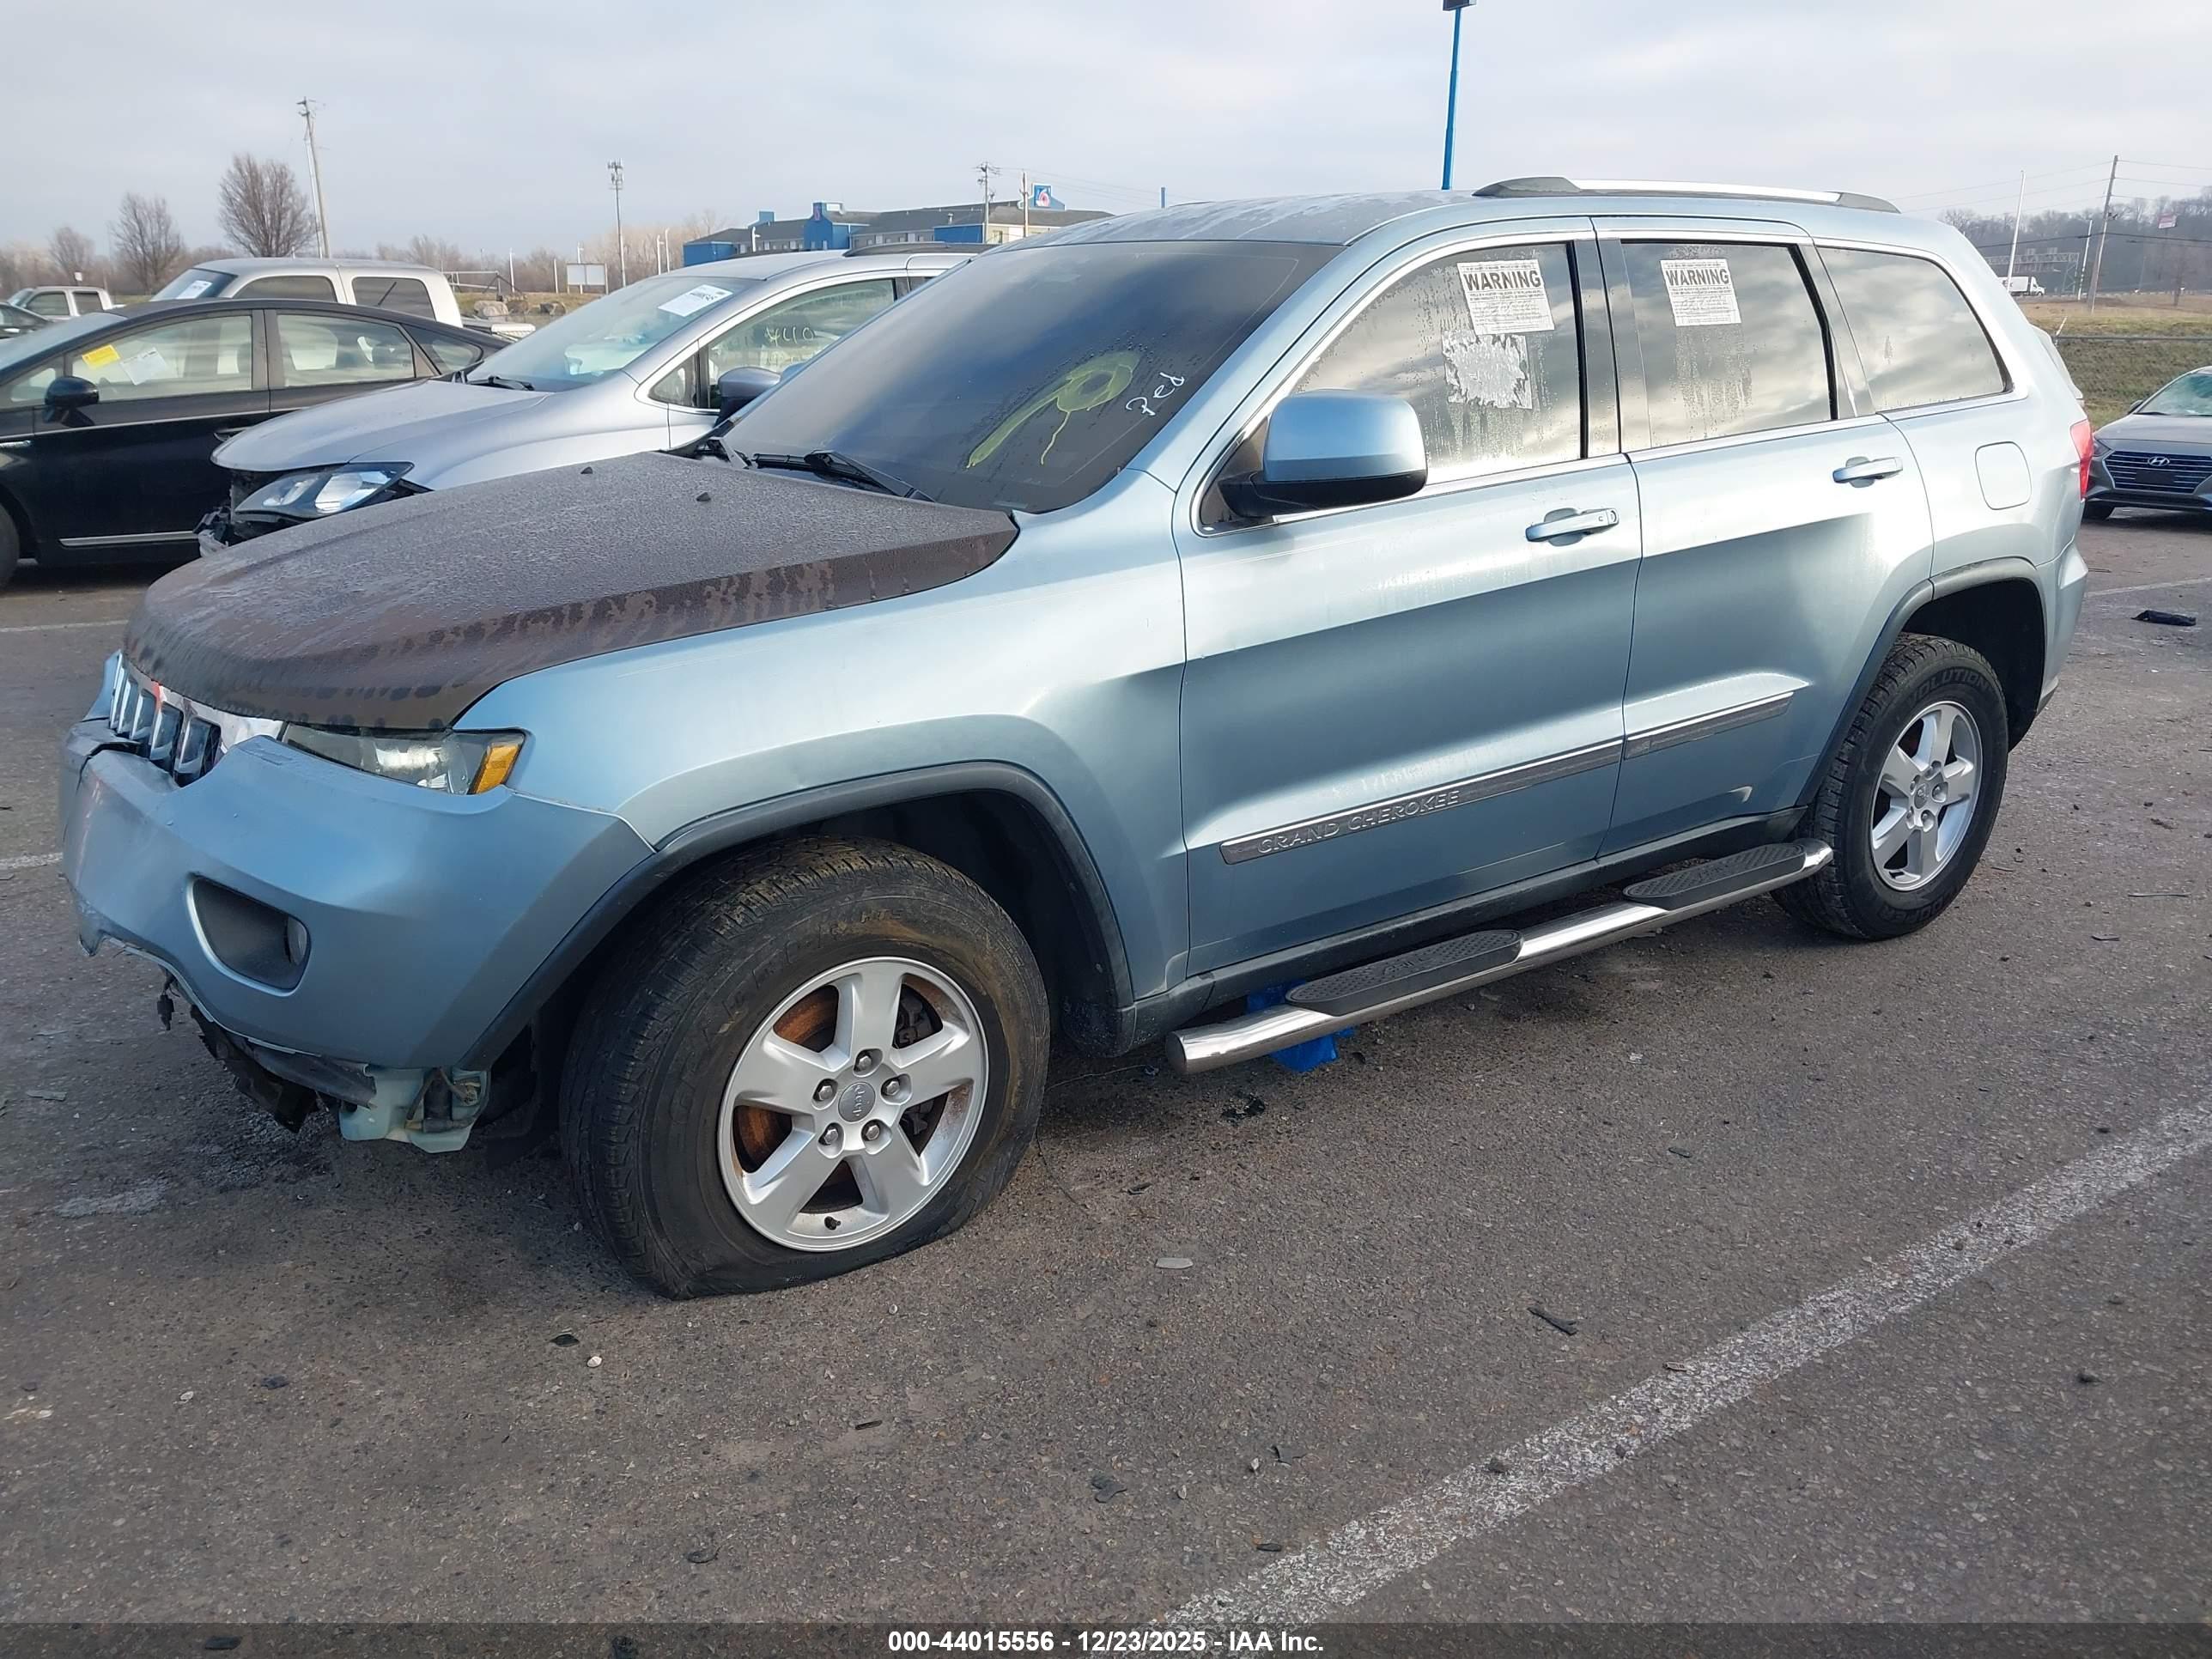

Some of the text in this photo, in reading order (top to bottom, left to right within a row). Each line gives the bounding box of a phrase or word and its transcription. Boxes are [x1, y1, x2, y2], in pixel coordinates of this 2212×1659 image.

[1462, 270, 1542, 291] WARNING
[1666, 268, 1729, 286] WARNING
[1257, 790, 1460, 854] GRAND CHEROKEE
